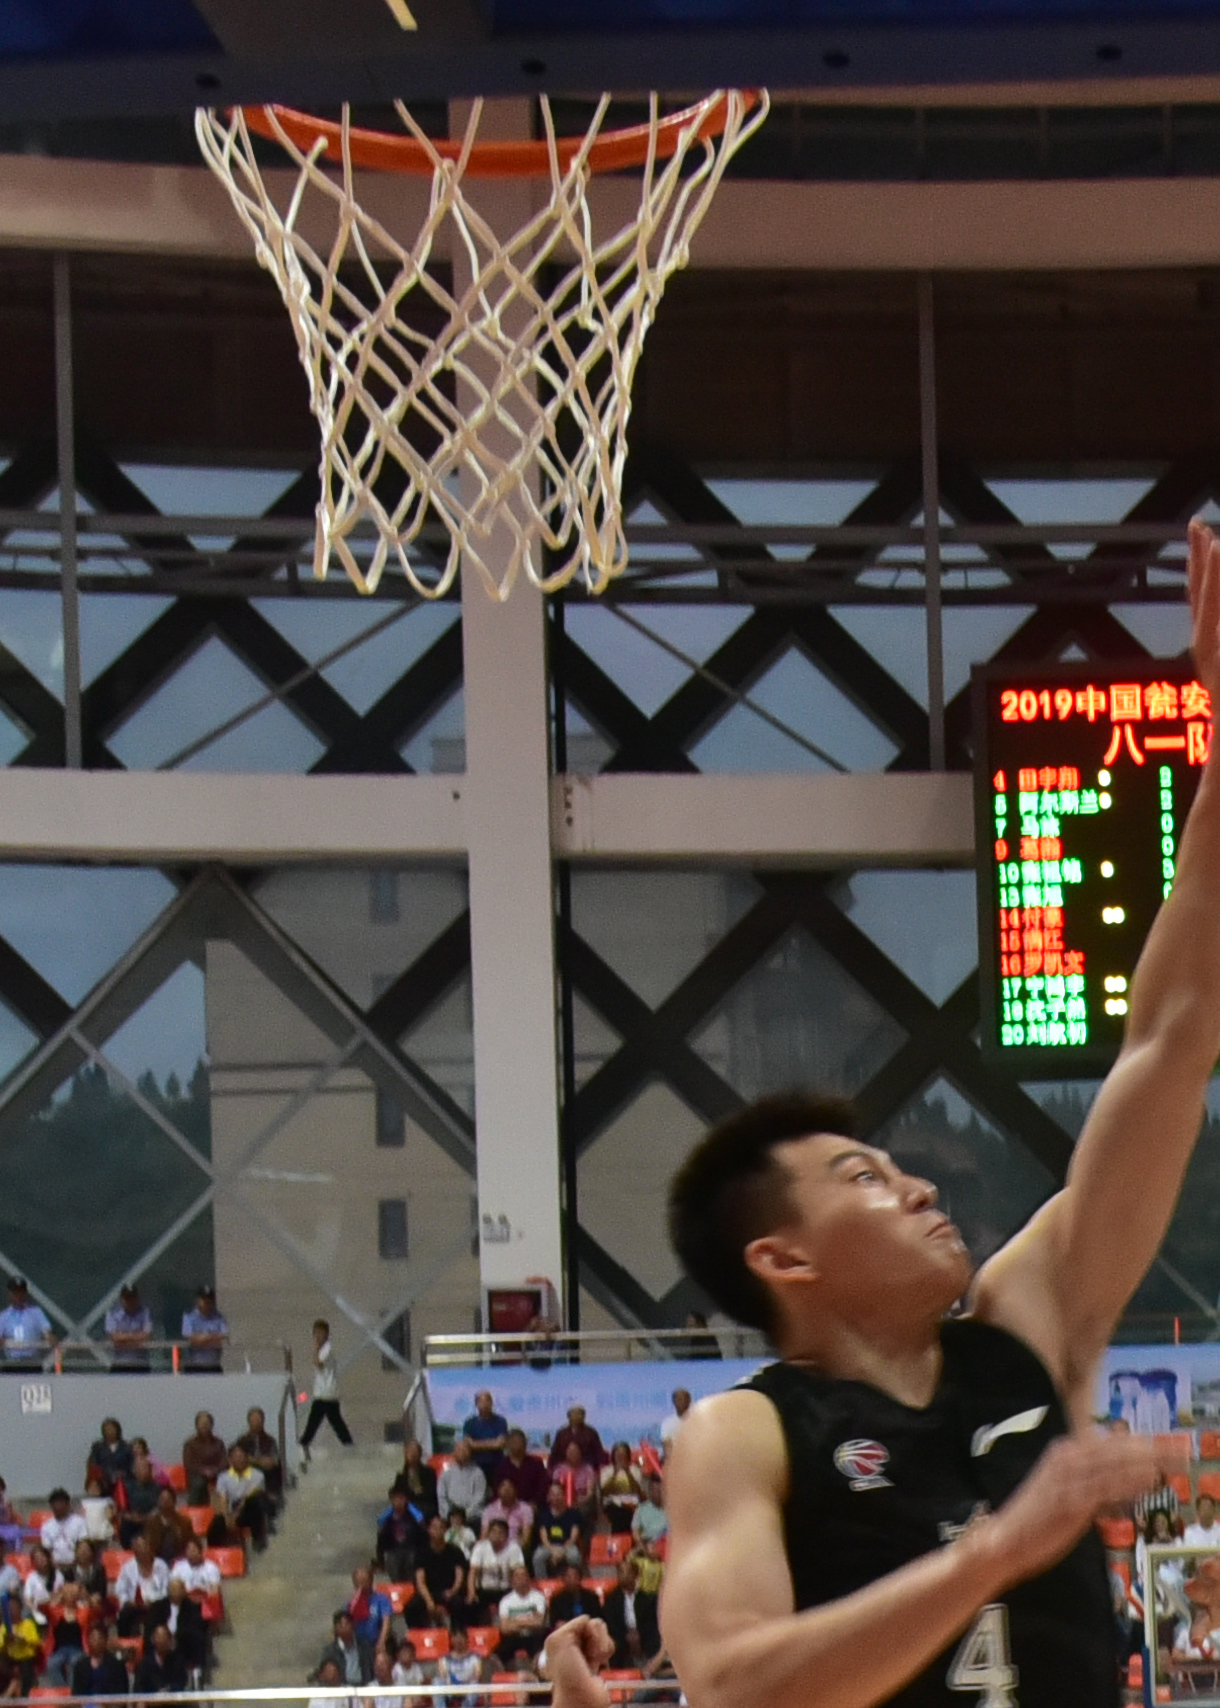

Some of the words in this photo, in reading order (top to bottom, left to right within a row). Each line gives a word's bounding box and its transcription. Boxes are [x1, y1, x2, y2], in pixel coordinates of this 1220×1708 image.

[1162, 813, 1173, 833] 0
[999, 862, 1019, 884] 10
[1001, 908, 1019, 928] 14
[1003, 977, 1021, 998] 17
